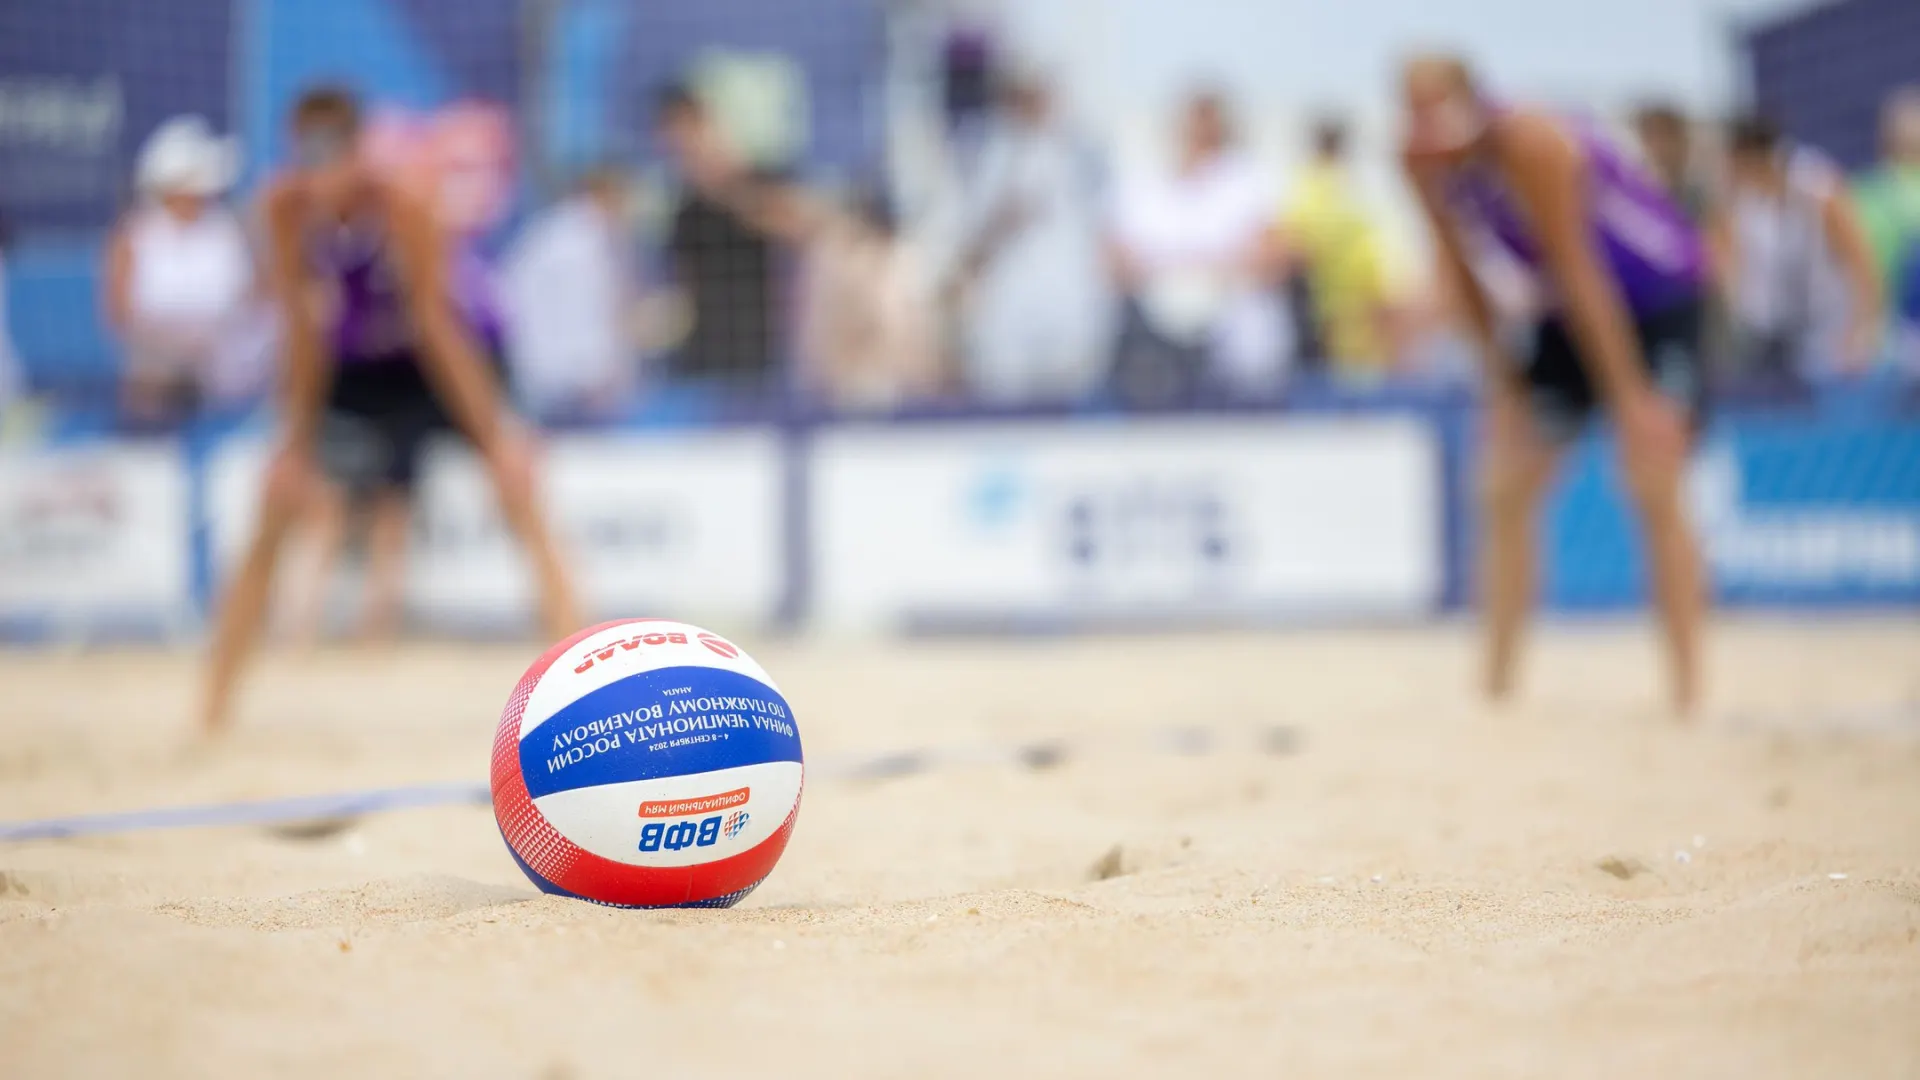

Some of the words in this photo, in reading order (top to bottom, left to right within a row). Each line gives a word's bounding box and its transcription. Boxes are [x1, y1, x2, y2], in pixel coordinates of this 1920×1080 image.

[662, 686, 692, 696] АНАПА
[668, 697, 767, 716] ПЛЯЖНОМУ
[768, 702, 785, 718] ПО
[553, 704, 663, 752] ВОЛЕЙБОЛУ
[624, 714, 750, 744] ЧЕМПИОНАТА
[752, 715, 793, 737] ФИНАЛ
[649, 741, 668, 752] 2024
[670, 734, 710, 747] СЕНТЯБРЯ
[547, 734, 621, 774] РОССИИ
[645, 805, 668, 814] МЯЧ
[669, 792, 746, 815] ОФИЦИАЛЬНЫЙ
[638, 815, 723, 852] ВФВ
